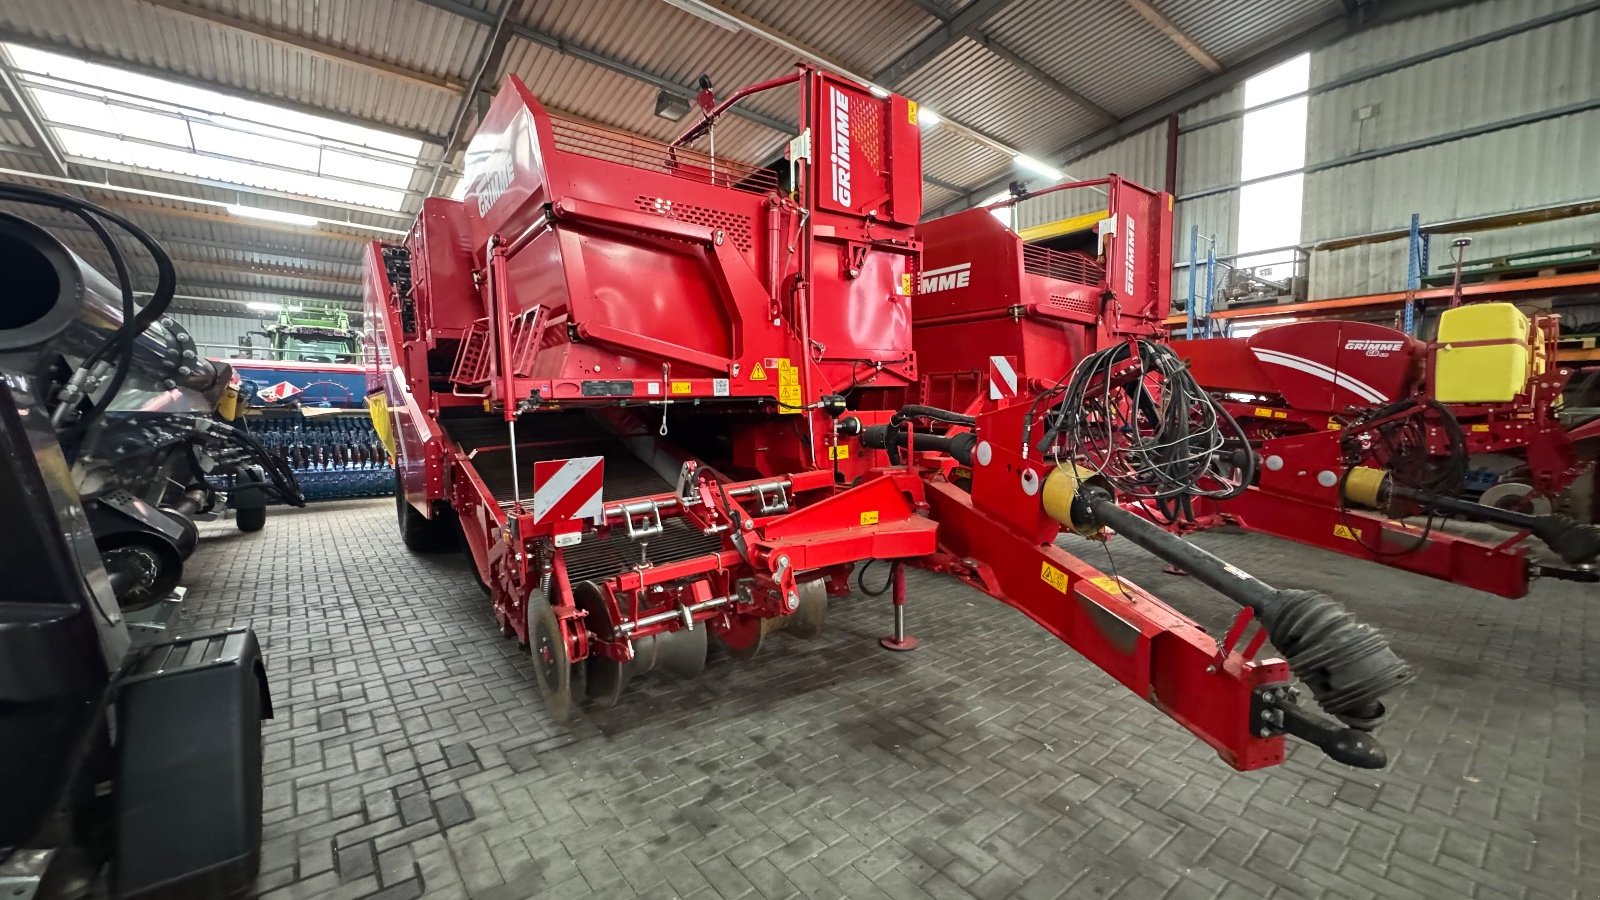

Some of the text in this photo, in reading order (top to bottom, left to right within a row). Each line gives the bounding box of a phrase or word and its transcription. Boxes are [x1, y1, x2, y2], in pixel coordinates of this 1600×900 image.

[830, 85, 851, 208] GRIMME
[476, 156, 515, 218] GRIMME
[918, 262, 972, 295] MME
[1125, 213, 1135, 296] GRIMME
[1344, 339, 1405, 351] GRIMME
